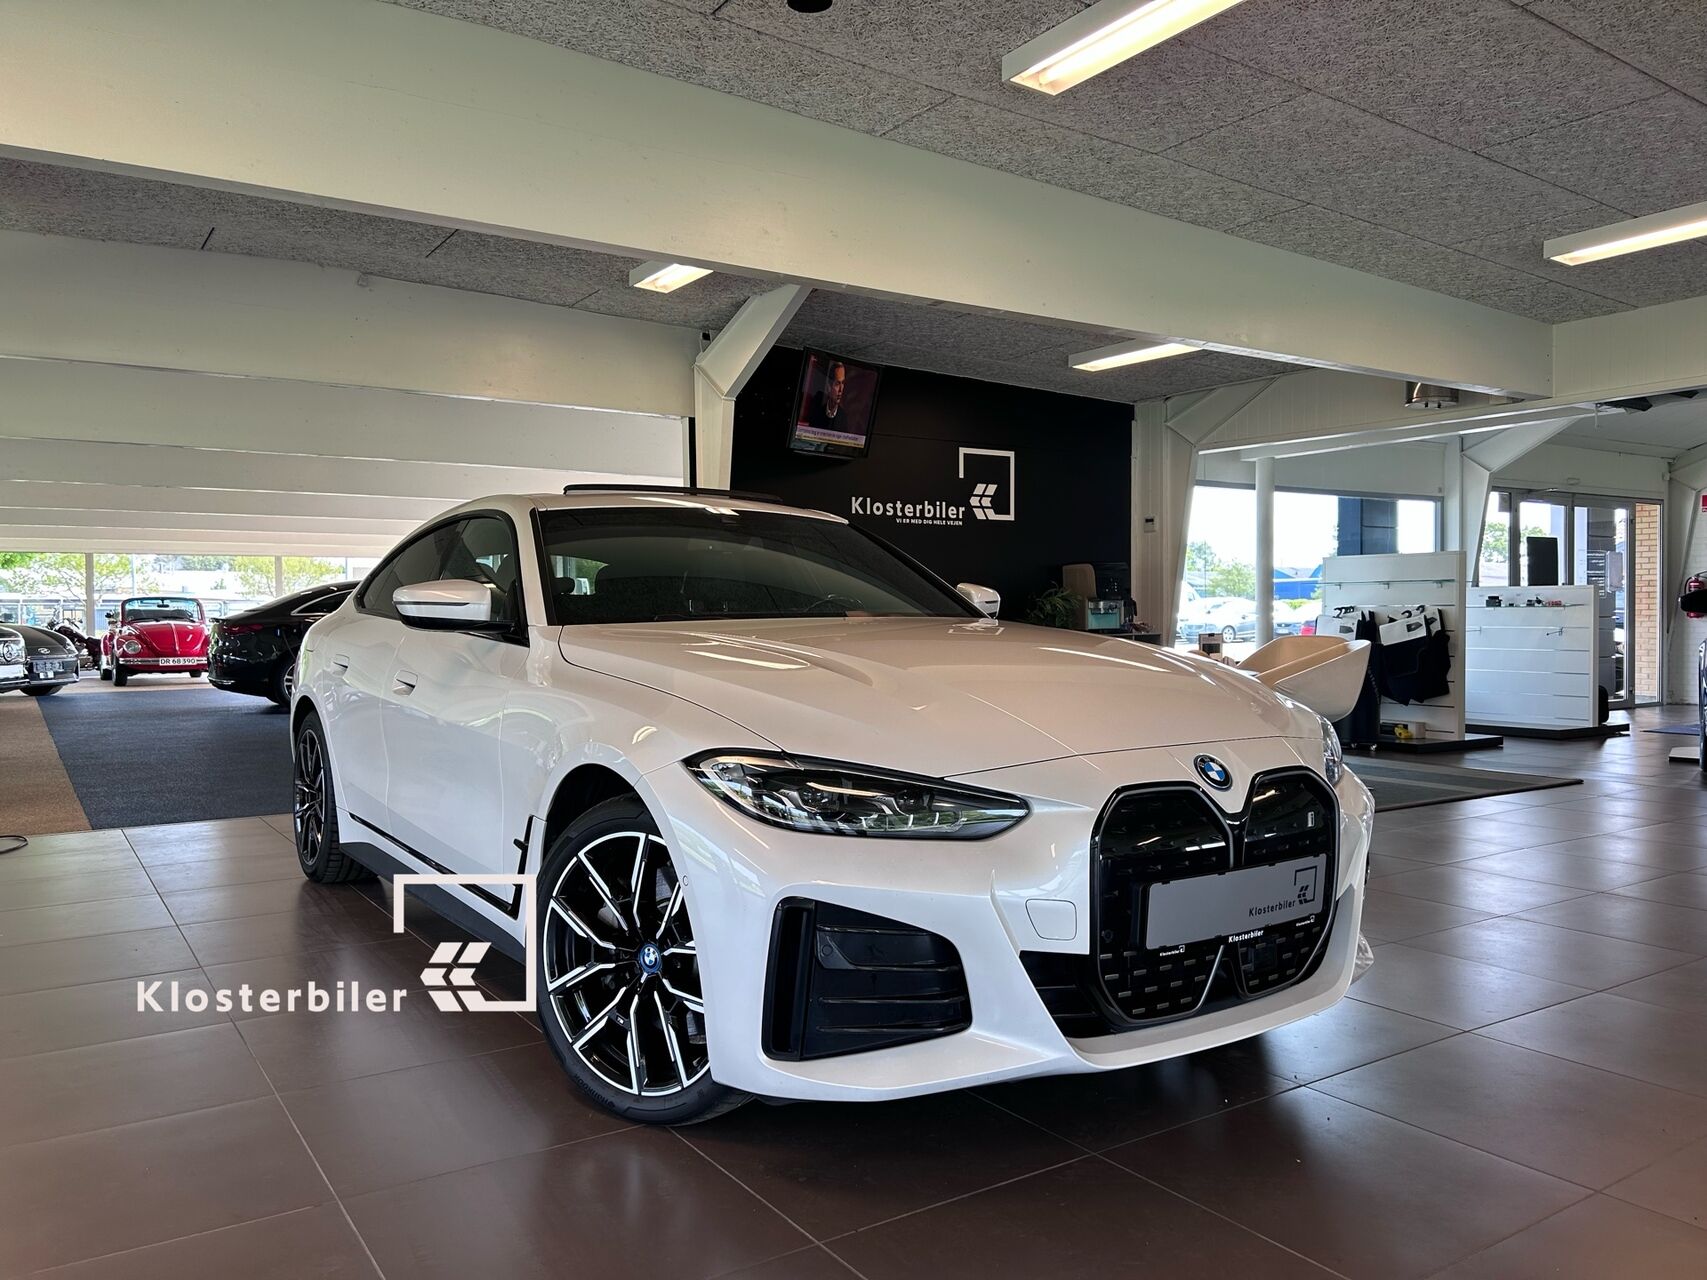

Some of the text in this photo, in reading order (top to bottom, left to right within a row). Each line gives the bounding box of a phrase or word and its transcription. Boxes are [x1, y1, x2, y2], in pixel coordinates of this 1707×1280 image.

[851, 496, 966, 519] Klosterbiler
[1248, 900, 1296, 917] Klosterbiler
[1228, 930, 1264, 943] Klosterbiler
